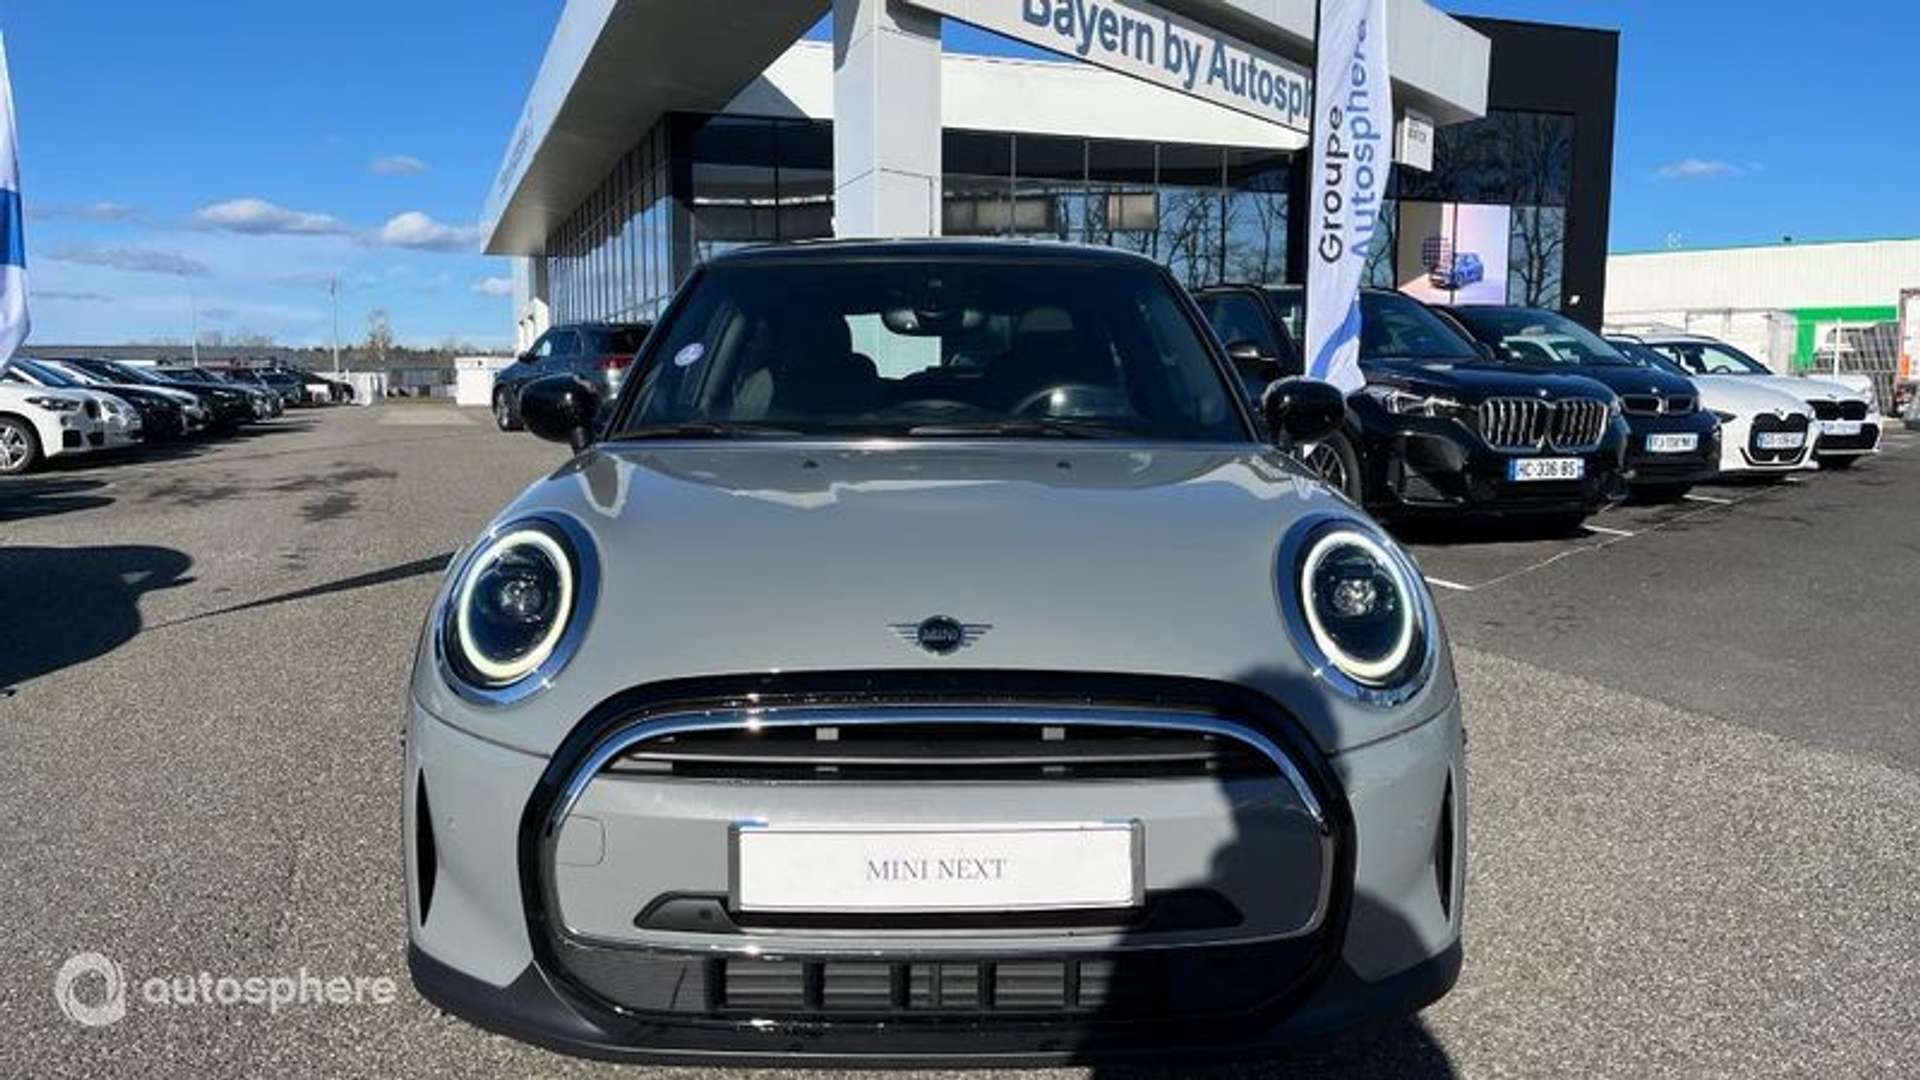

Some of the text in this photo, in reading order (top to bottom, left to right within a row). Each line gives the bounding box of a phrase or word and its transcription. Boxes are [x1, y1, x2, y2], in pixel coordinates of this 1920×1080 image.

[1163, 17, 1202, 90] by
[1318, 105, 1350, 264] Groupe
[866, 858, 1008, 880] MINI NEXT
